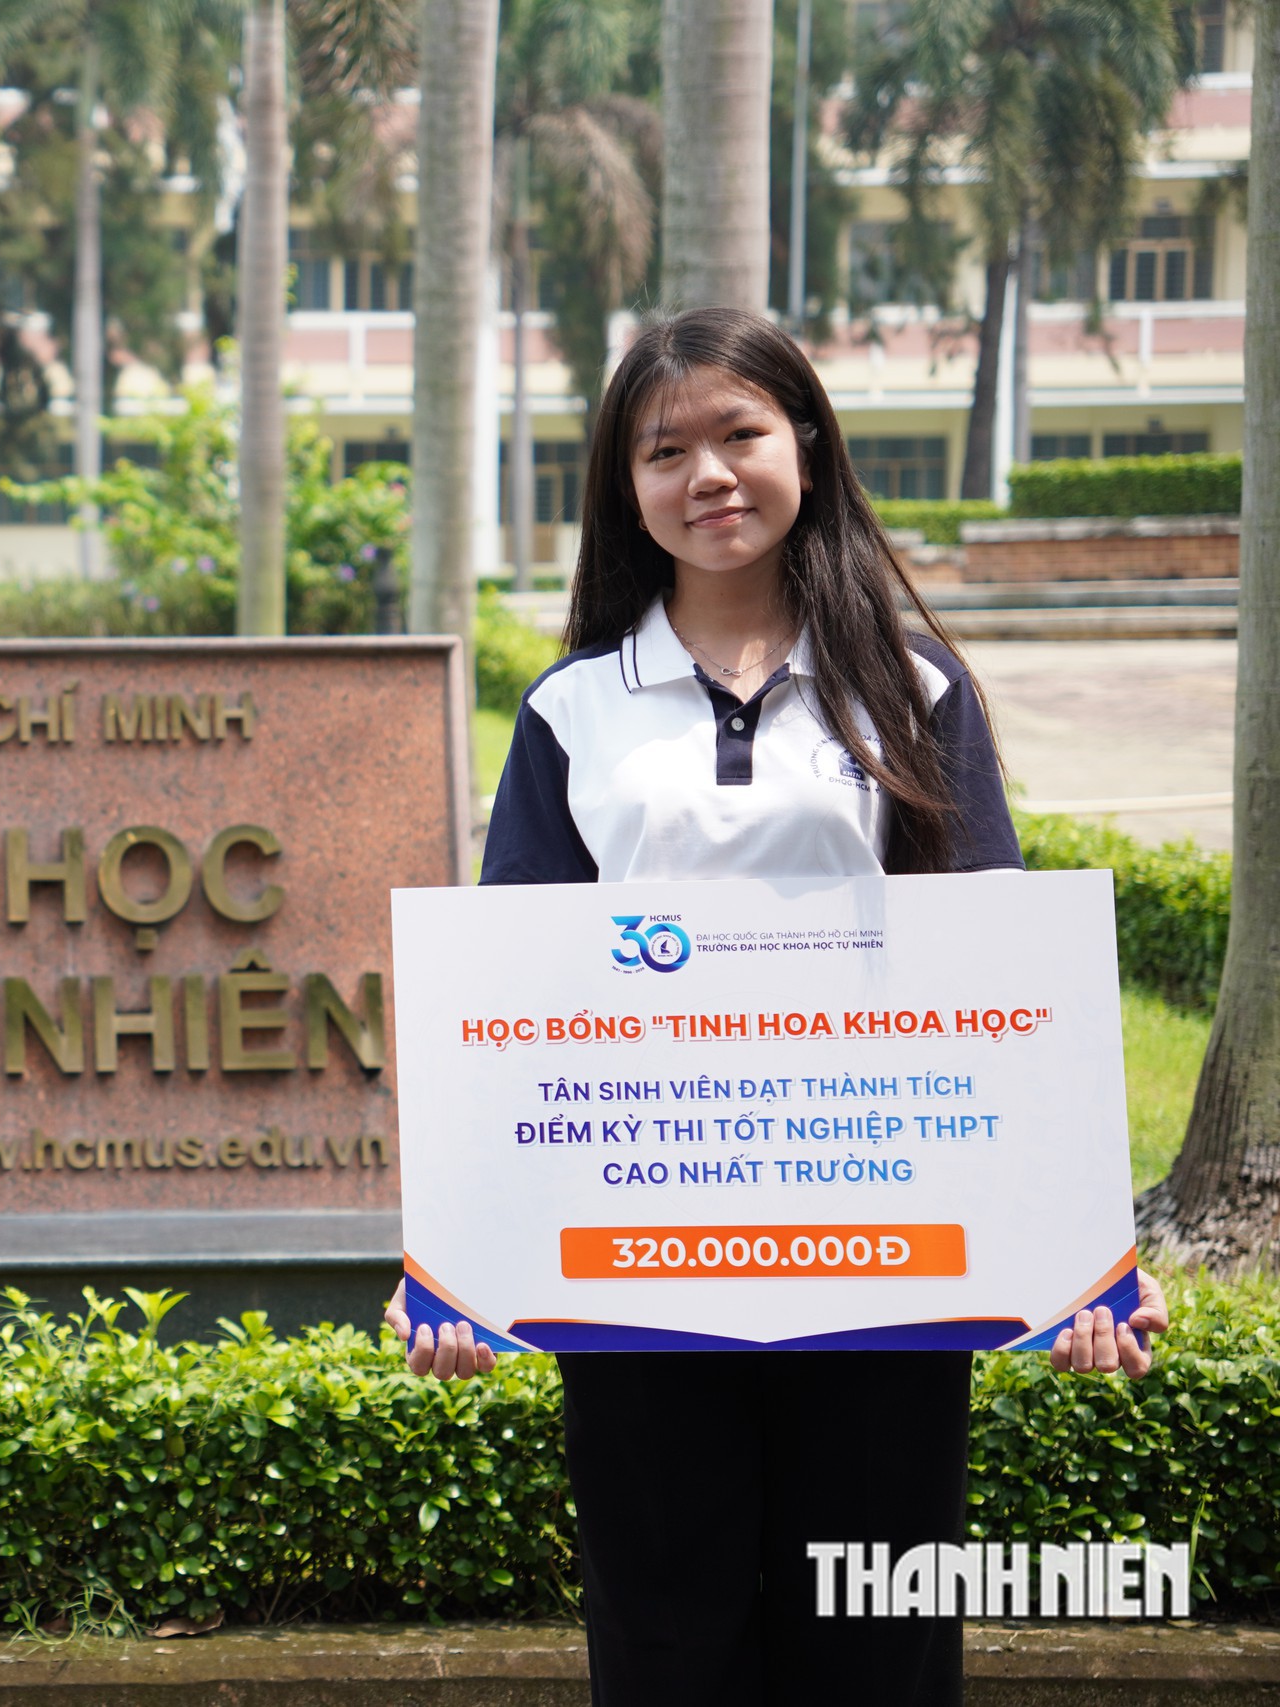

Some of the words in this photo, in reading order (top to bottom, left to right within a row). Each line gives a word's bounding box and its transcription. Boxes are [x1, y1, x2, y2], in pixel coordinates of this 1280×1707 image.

[104, 693, 255, 742] MINH
[5, 824, 284, 951] HỌC
[649, 914, 682, 922] HCMUS
[739, 943, 757, 953] ĐẠI
[760, 942, 780, 953] HỌC
[783, 942, 811, 950] KHOA
[813, 941, 834, 952] HỌC
[852, 938, 883, 949] NHIÊN
[759, 932, 775, 940] GIA
[860, 930, 883, 938] MINH
[3, 948, 386, 1075] NHIÊN
[462, 1018, 536, 1049] HỌC
[546, 1009, 642, 1041] BỔNG
[652, 1014, 748, 1039] "TINH
[758, 1012, 834, 1036] HOA
[844, 1010, 945, 1035] KHOA
[955, 1008, 1049, 1040] HỌC"
[538, 1077, 590, 1102] TÂN
[599, 1081, 661, 1100] SINH
[670, 1074, 731, 1100] VIÊN
[738, 1079, 792, 1103] ĐẠT
[801, 1072, 898, 1098] THÀNH
[907, 1070, 973, 1096] TÍCH
[515, 1113, 592, 1144] ĐIỂM
[602, 1114, 643, 1143] KỲ
[653, 1119, 704, 1142] THI
[713, 1111, 775, 1141] TỐT
[786, 1110, 904, 1145] NGHIỆP
[914, 1115, 1000, 1139] THPT
[602, 1162, 669, 1185] CAO
[679, 1153, 764, 1184] NHẤT
[774, 1152, 913, 1183] TRƯỜNG
[612, 1235, 911, 1268] 320.000.000Đ
